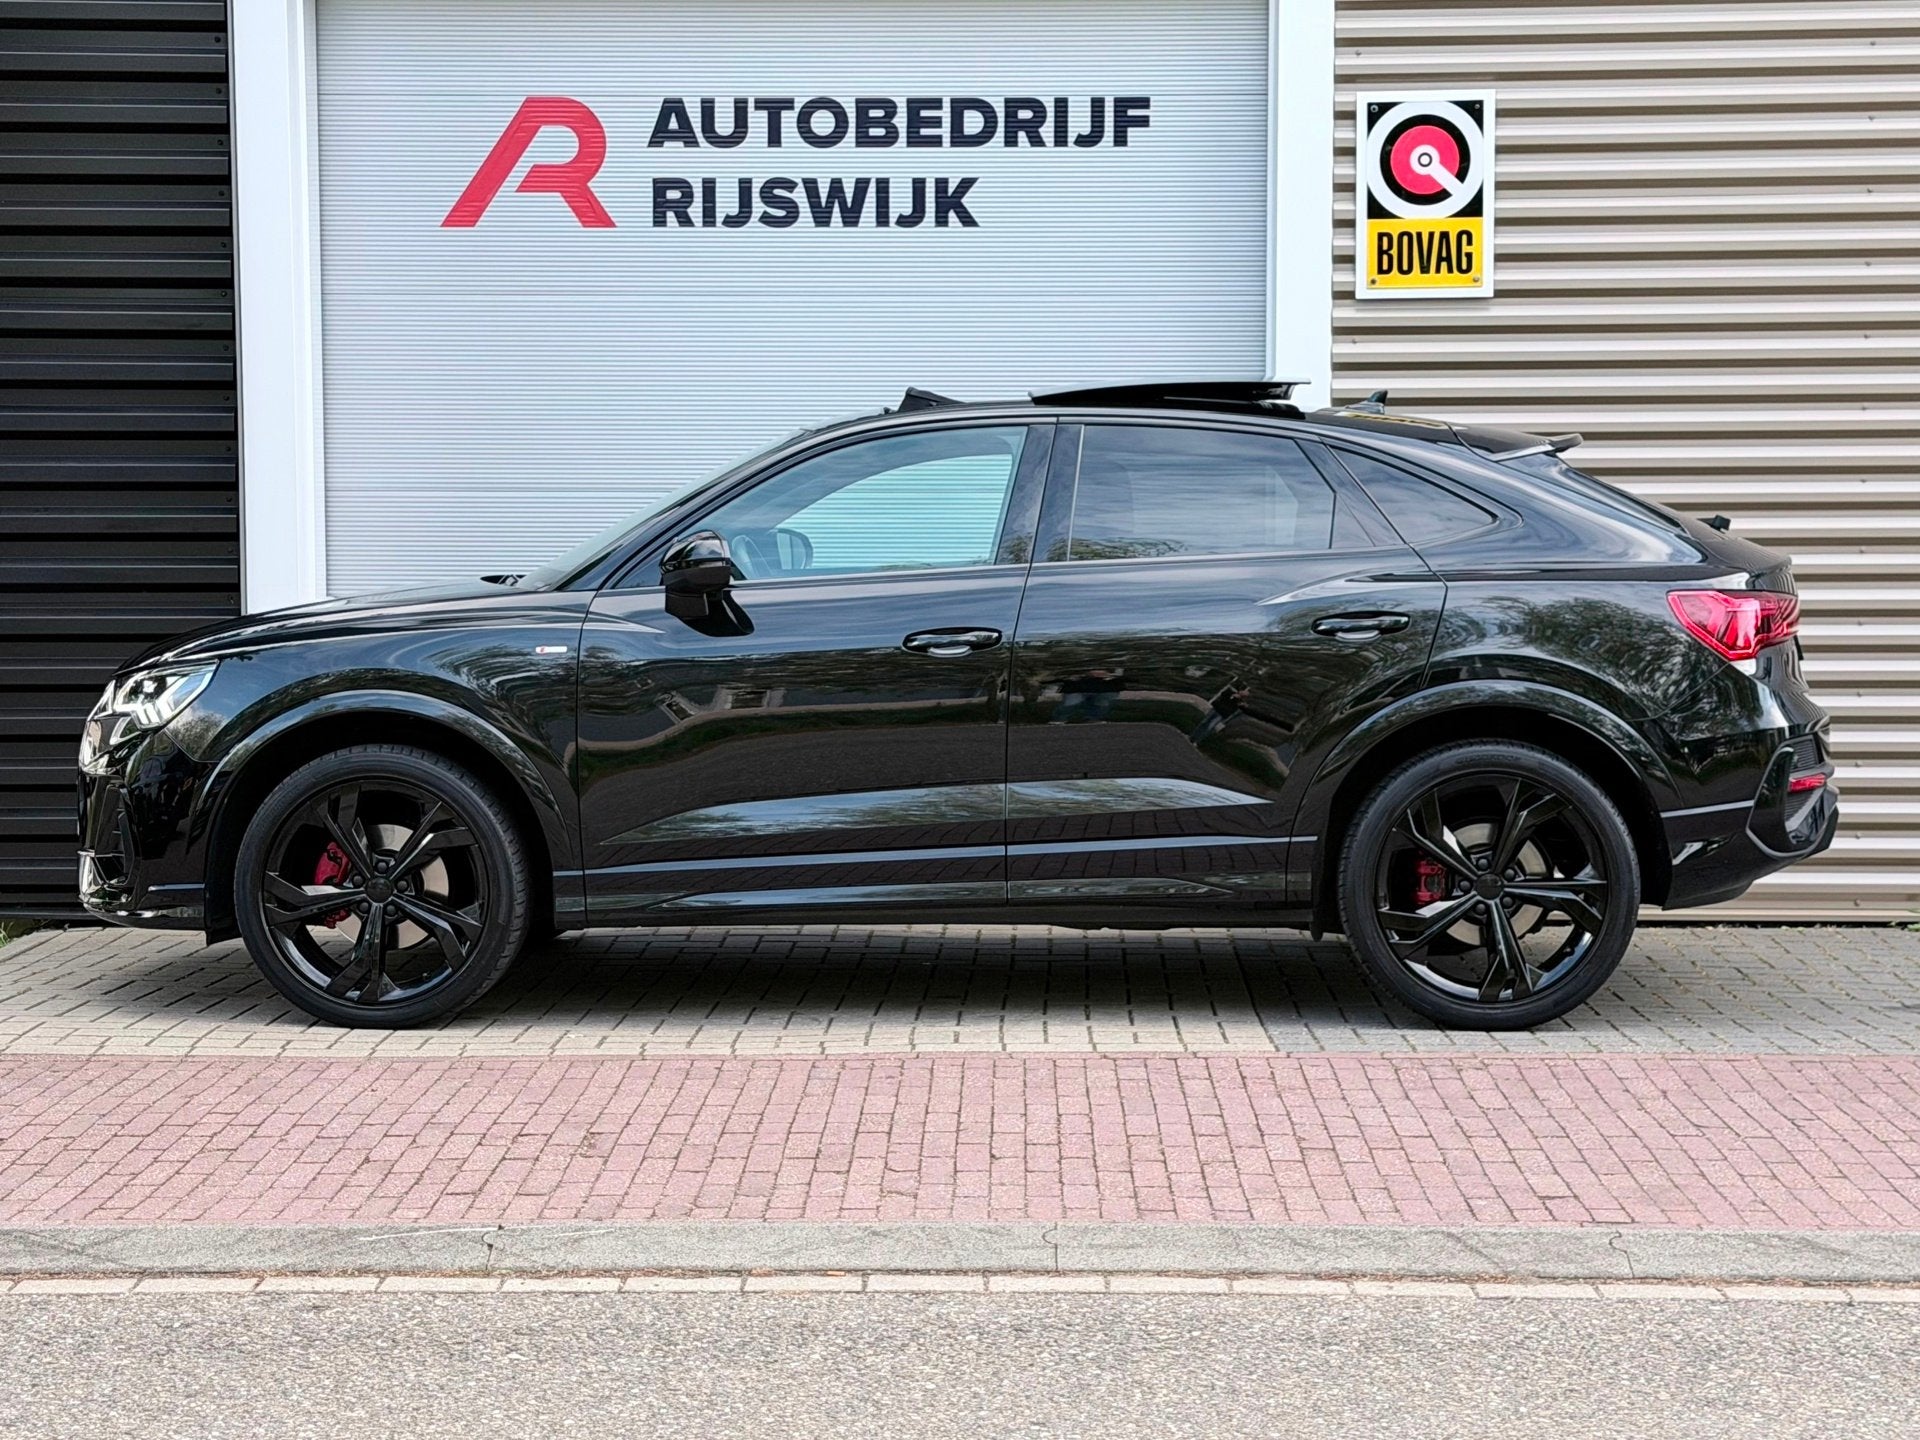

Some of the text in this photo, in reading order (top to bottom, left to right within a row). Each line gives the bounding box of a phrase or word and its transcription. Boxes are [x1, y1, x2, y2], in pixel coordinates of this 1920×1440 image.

[647, 97, 1151, 148] AUTOBEDRIJF
[652, 177, 981, 228] RIJSWIJK
[1377, 230, 1474, 275] BOVAG
